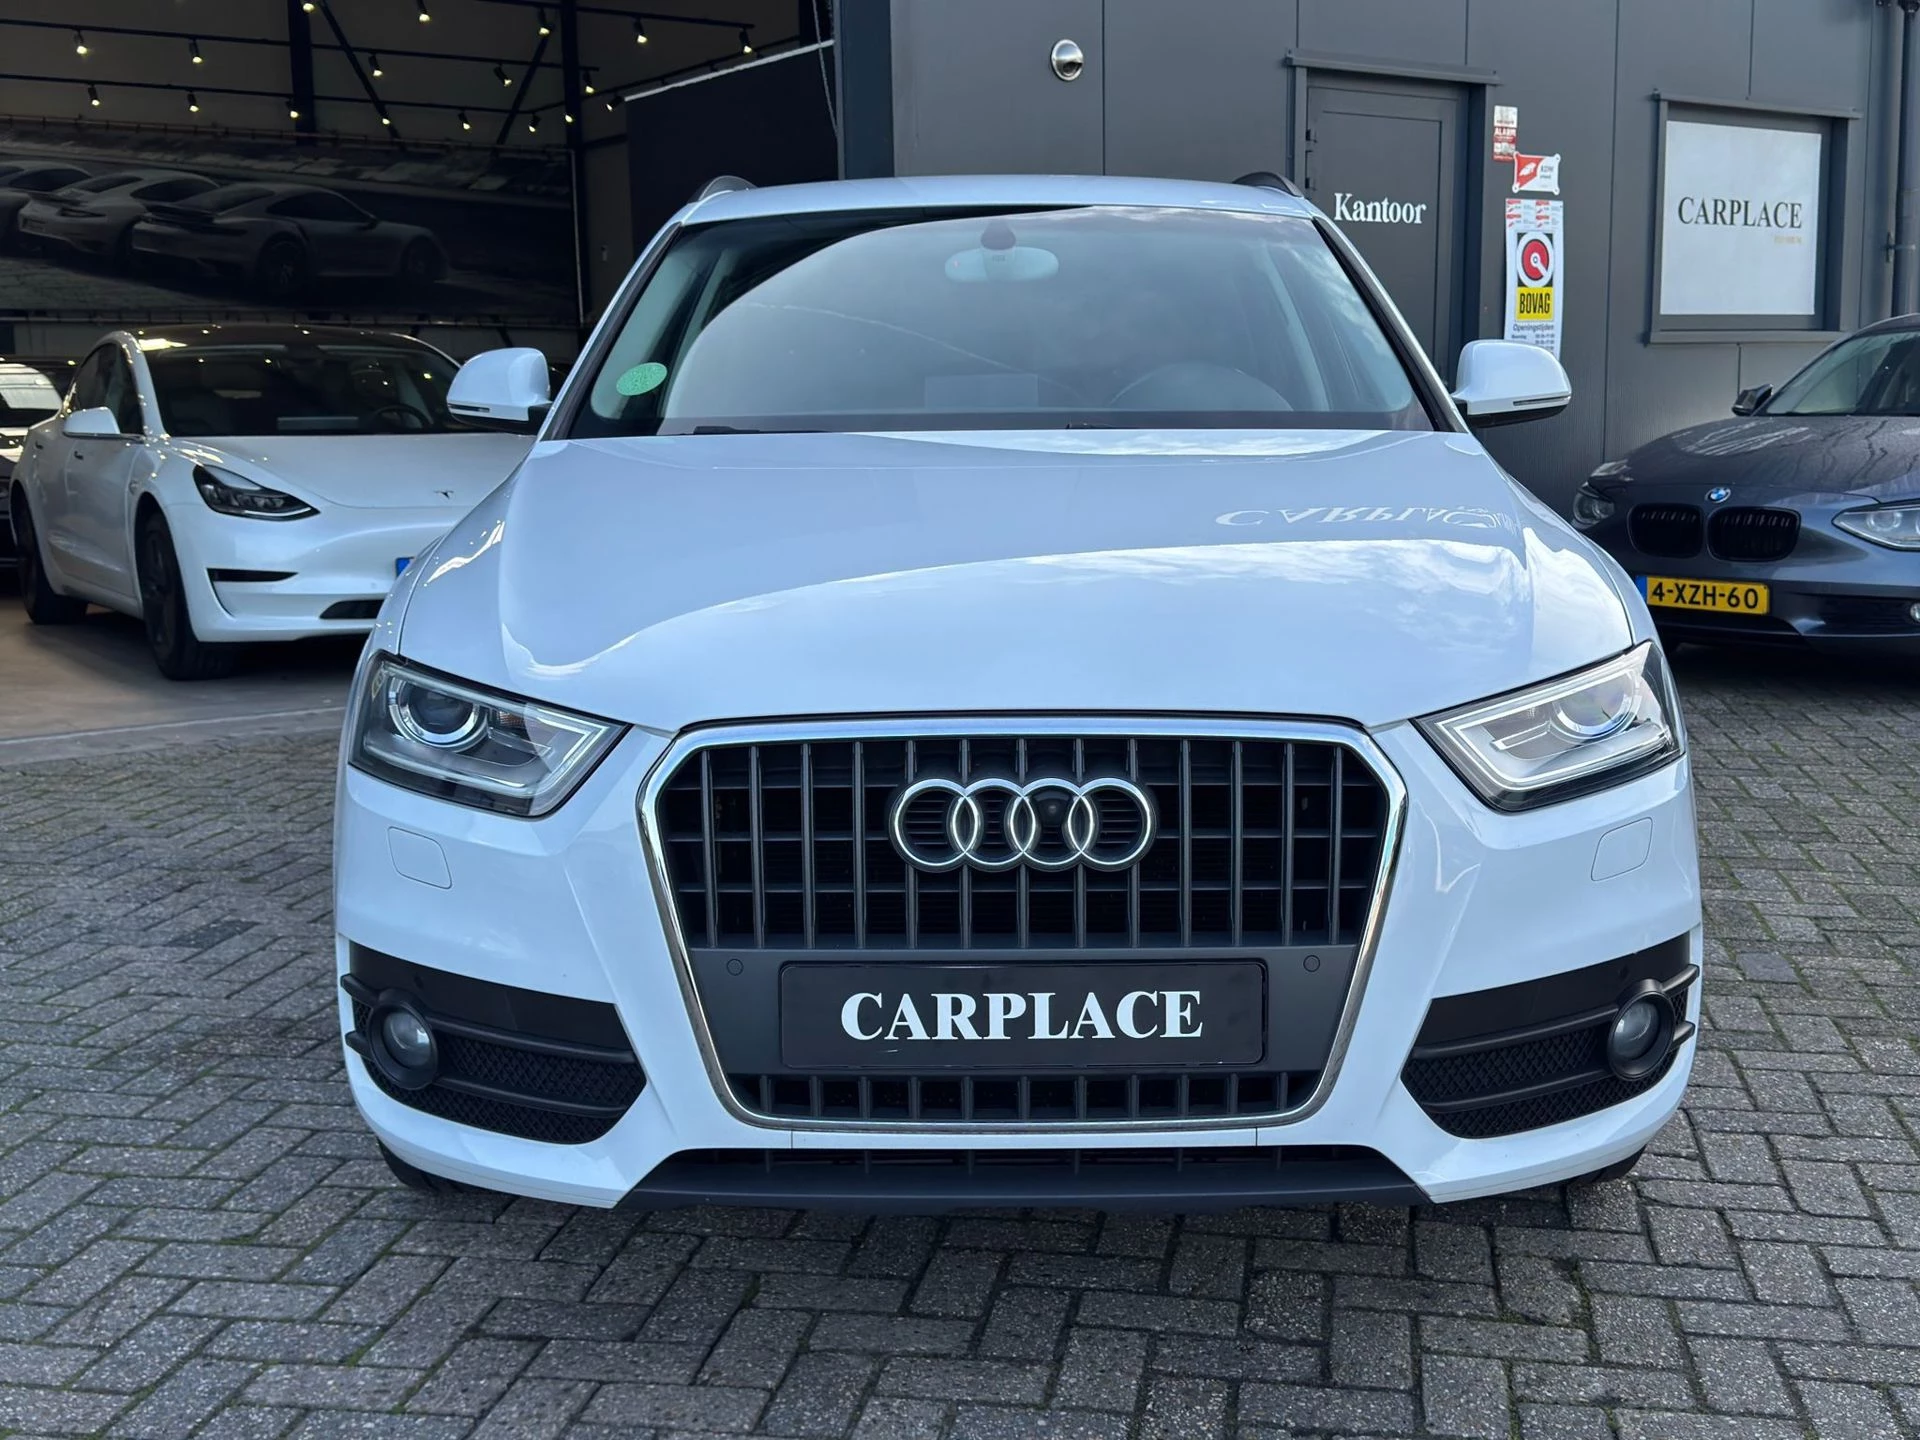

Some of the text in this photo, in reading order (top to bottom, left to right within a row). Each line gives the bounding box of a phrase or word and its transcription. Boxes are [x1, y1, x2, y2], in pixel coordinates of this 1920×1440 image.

[1334, 192, 1427, 224] Kantoor
[1678, 196, 1802, 229] CARPLACE
[1519, 293, 1551, 314] BOVAG
[1651, 582, 1759, 609] 4-XZH-60
[840, 990, 1204, 1040] CARPLACE
